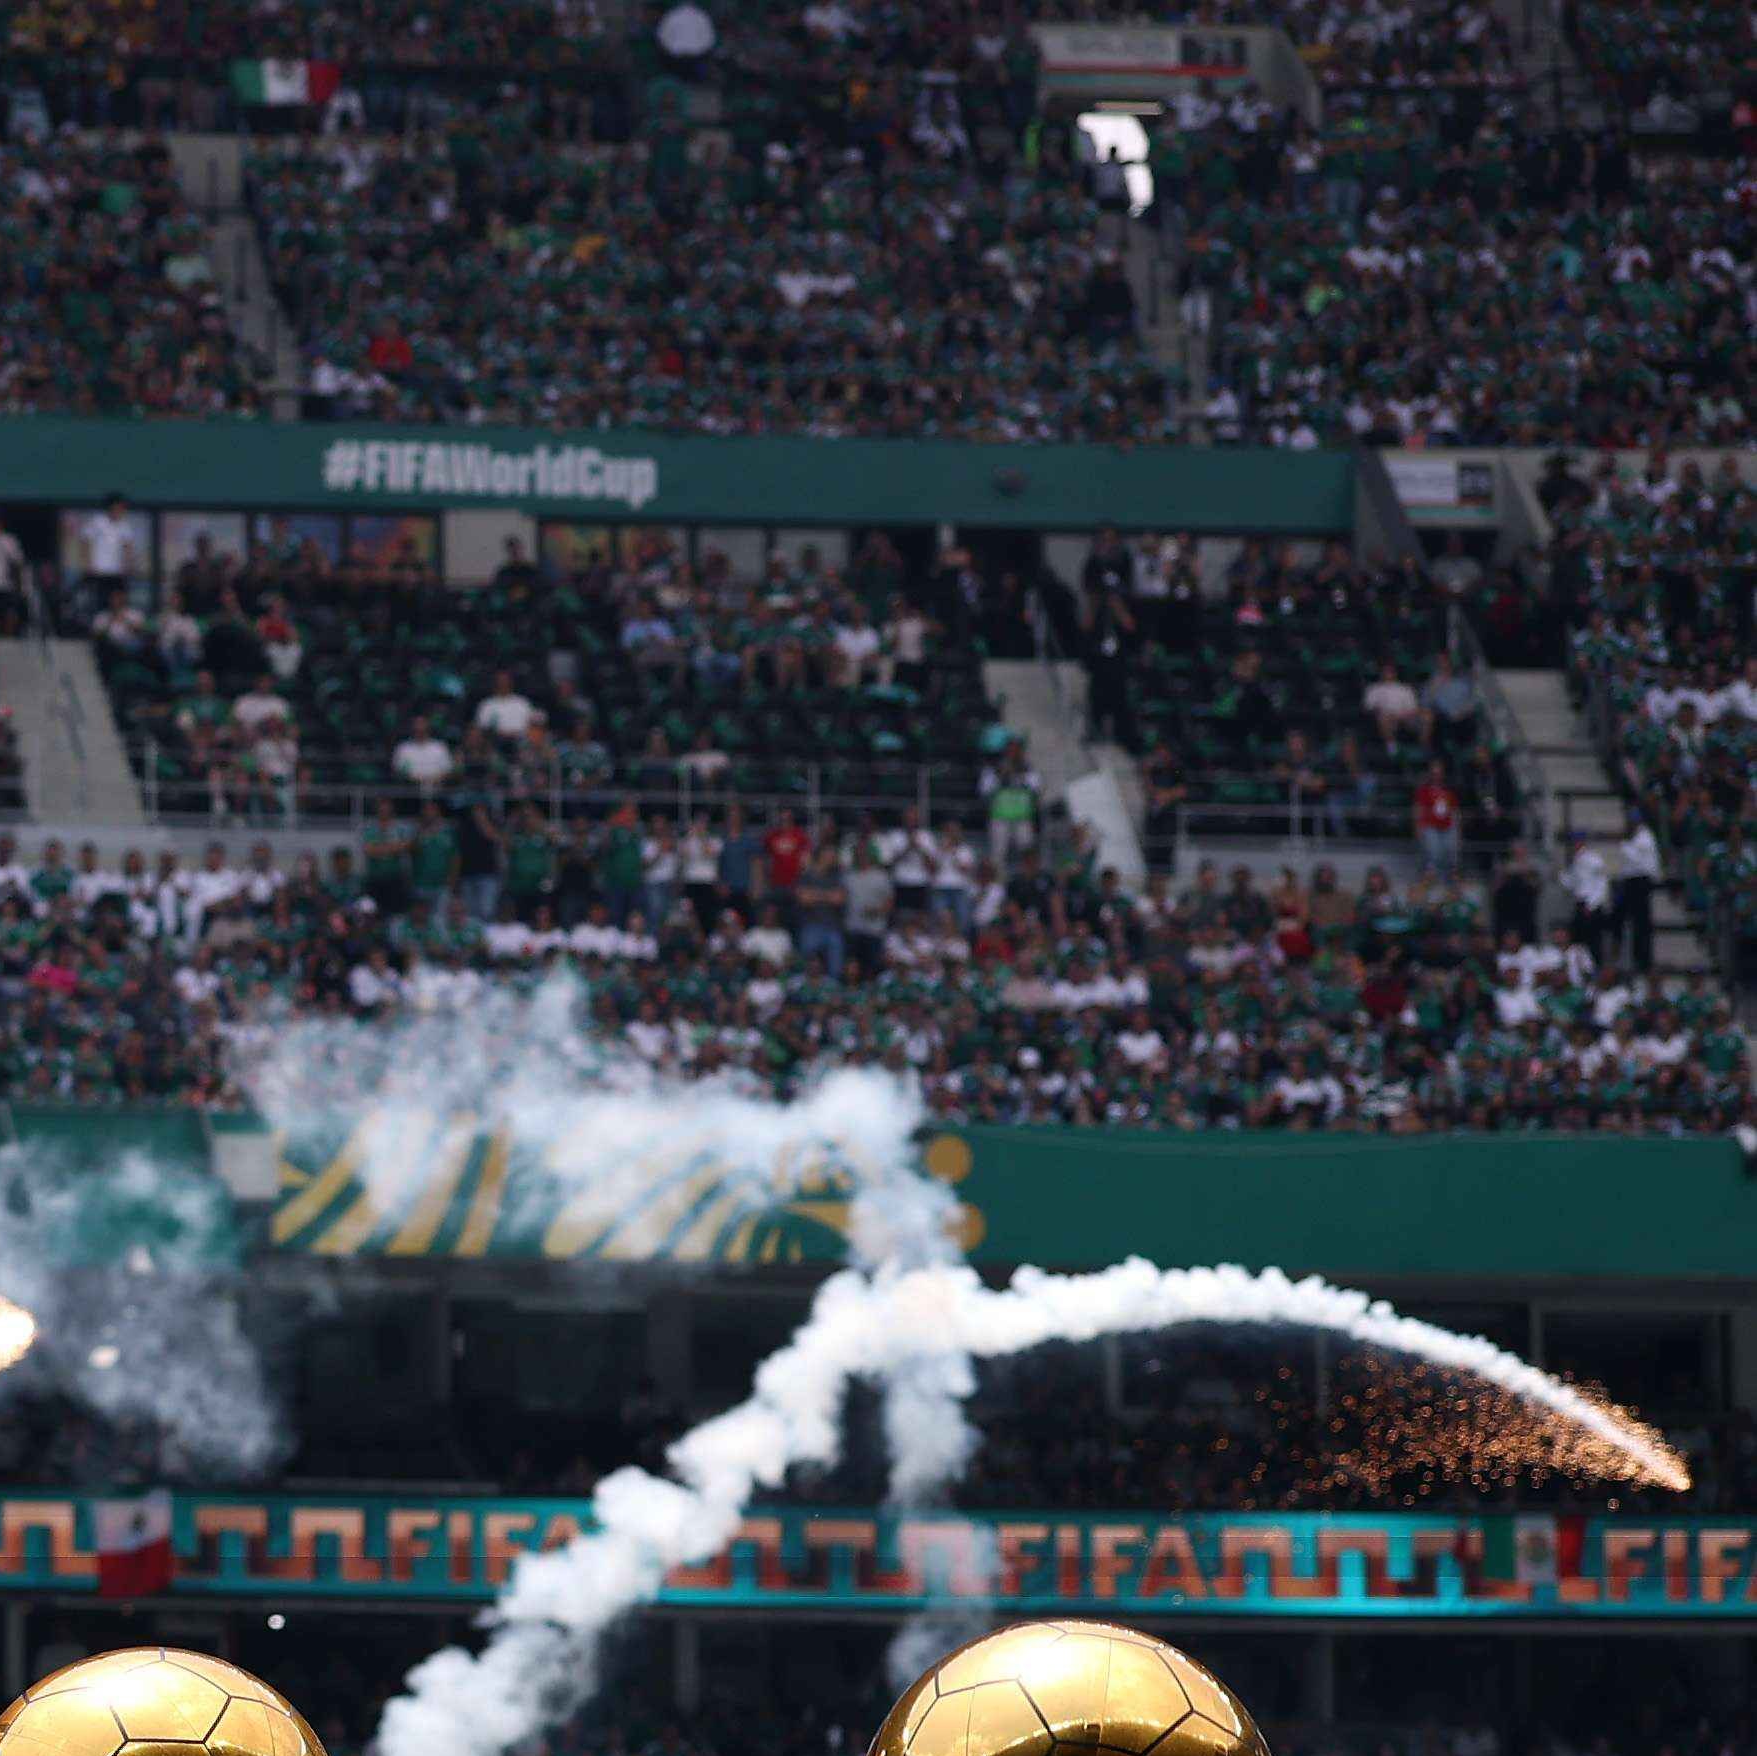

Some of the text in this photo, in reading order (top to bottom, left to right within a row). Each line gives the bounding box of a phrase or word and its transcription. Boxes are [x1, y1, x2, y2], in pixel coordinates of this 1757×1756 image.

[323, 439, 660, 509] #FIFAWorldCup
[998, 1523, 1208, 1600] FIFA
[1604, 1528, 1757, 1604] FIF
